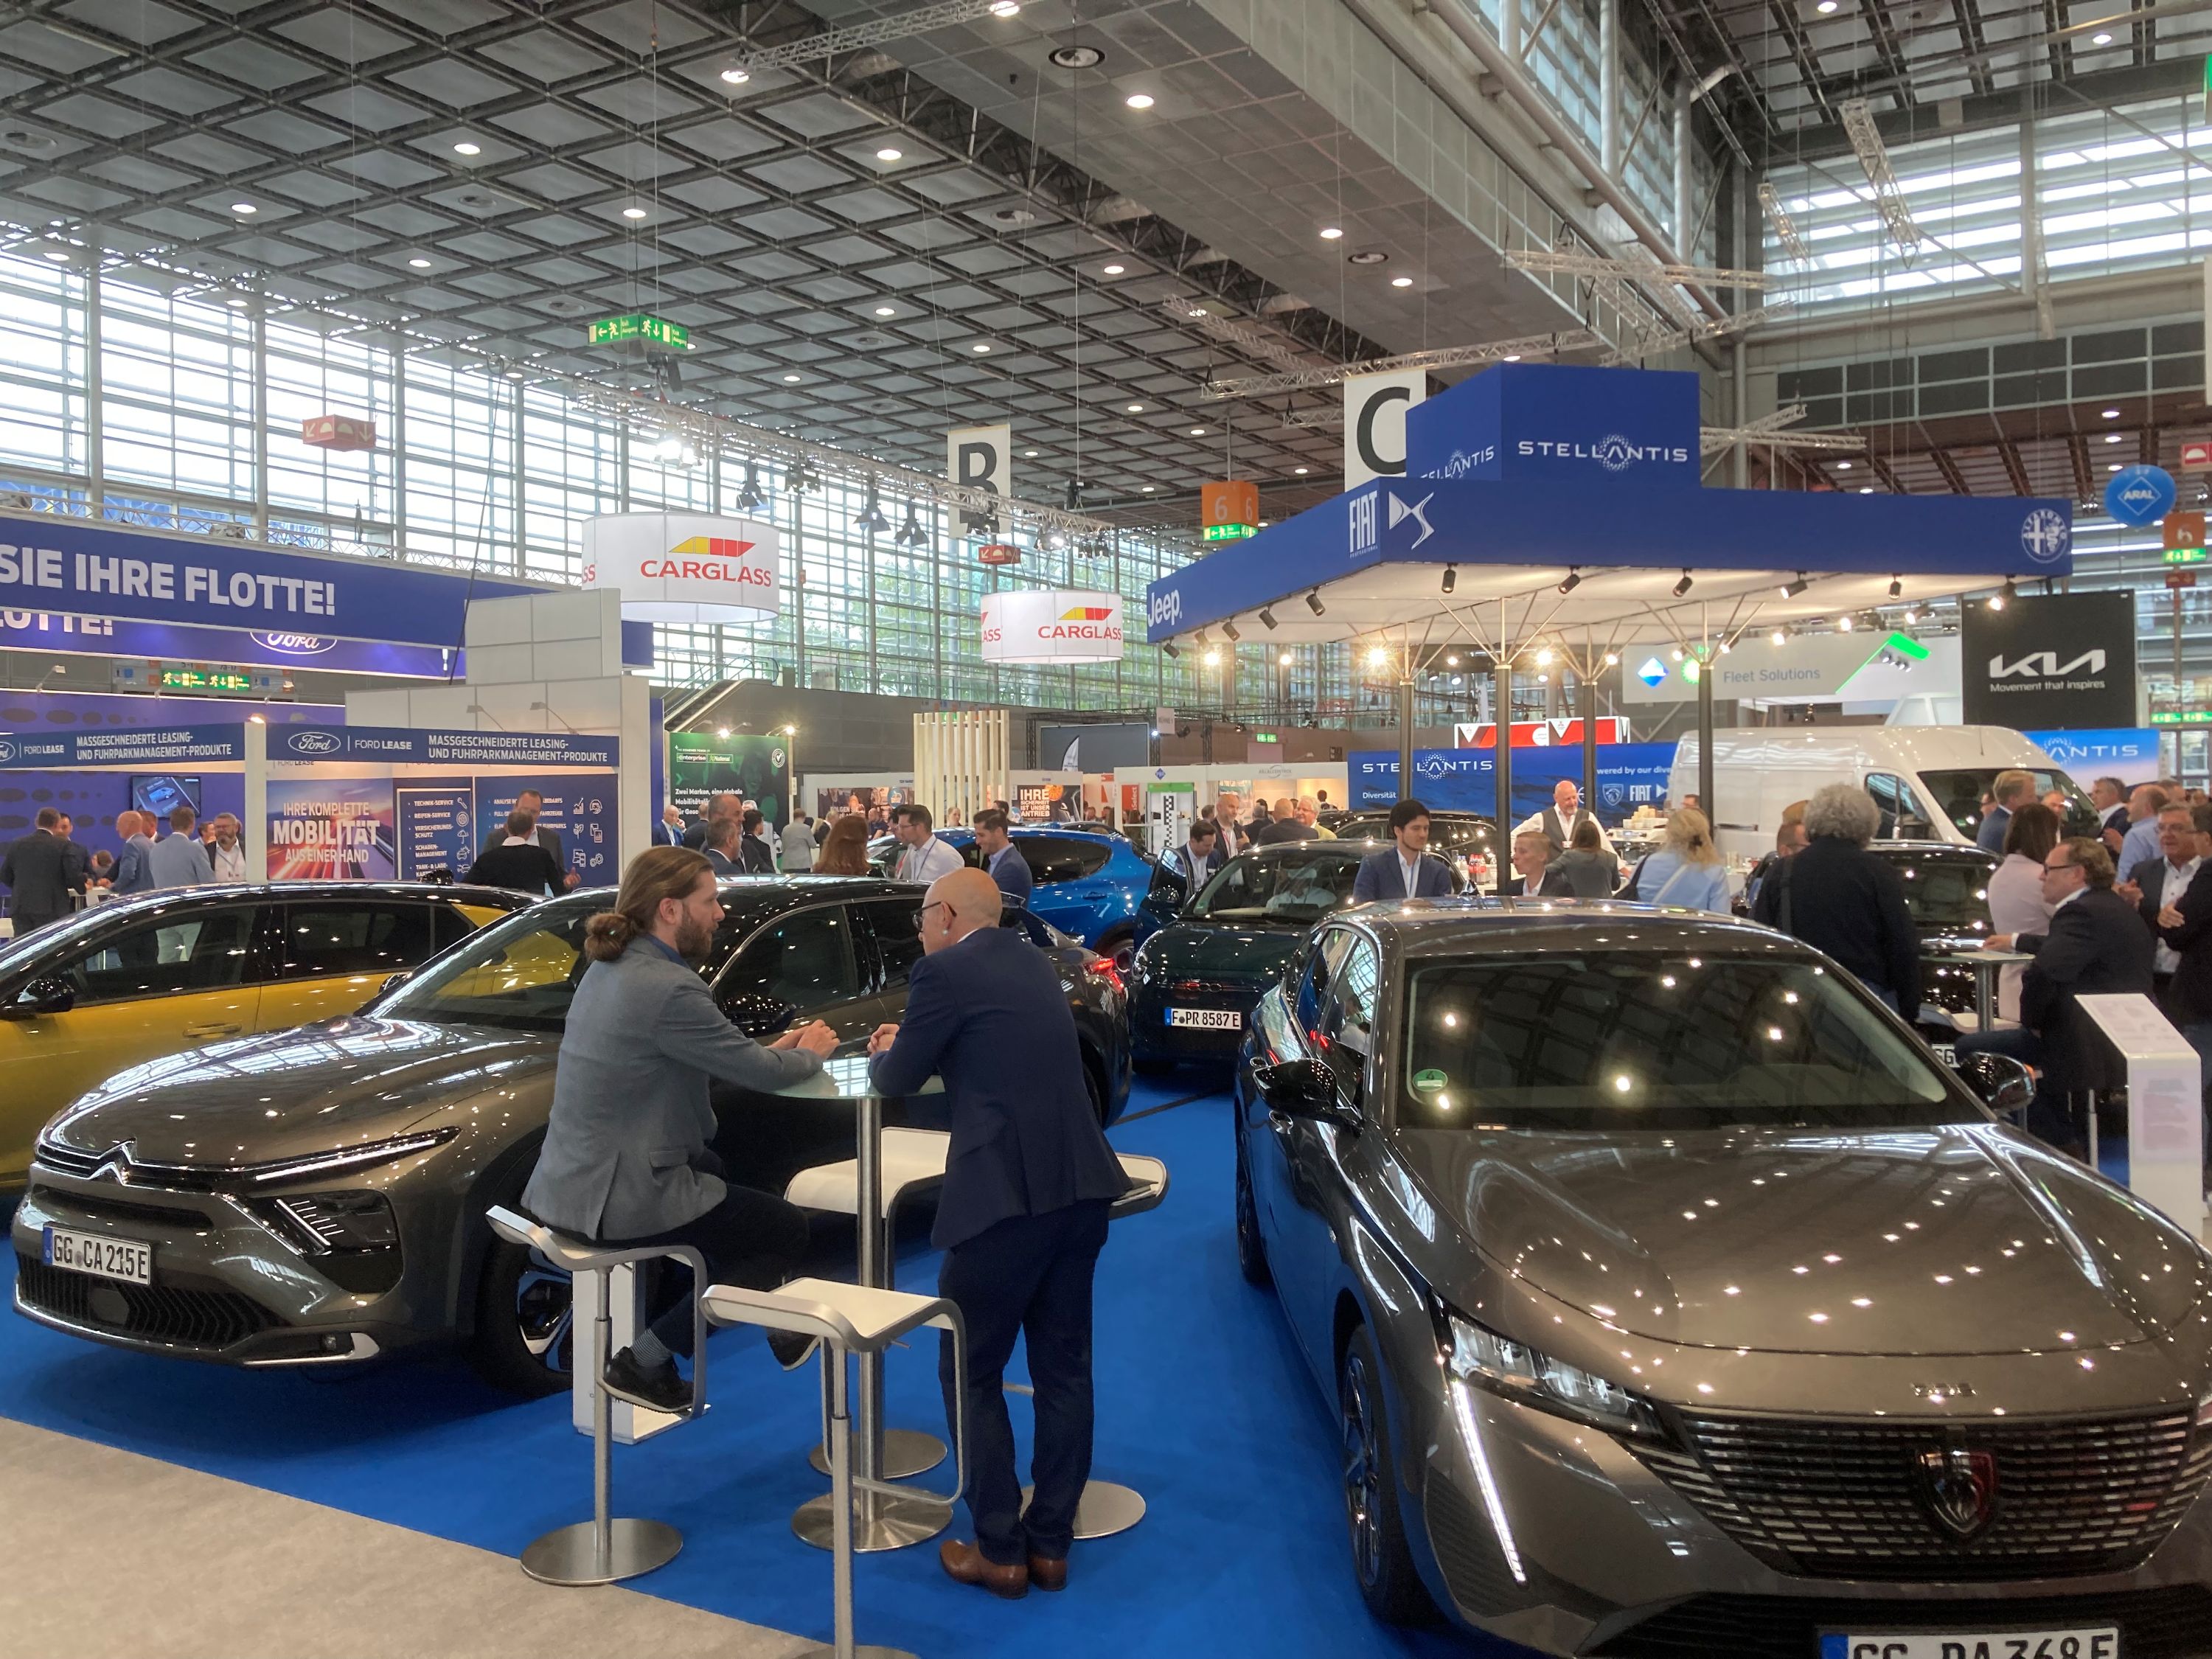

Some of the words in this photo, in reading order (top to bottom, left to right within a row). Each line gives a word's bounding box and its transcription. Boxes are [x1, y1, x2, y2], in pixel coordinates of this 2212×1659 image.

[1357, 386, 1410, 475] C
[1518, 440, 1688, 462] STELLANTIS
[1420, 445, 1495, 479] ELLANTIS
[959, 442, 1000, 525] B
[2123, 489, 2155, 501] ARAL
[1214, 495, 1228, 521] 6
[1245, 497, 1253, 521] 6
[1349, 490, 1378, 553] FIAT
[0, 543, 63, 589] SIE
[75, 553, 175, 599] IHRE
[185, 566, 335, 616] FLOTTE!
[582, 563, 596, 584] SS
[640, 560, 771, 588] CARGLASS
[982, 628, 1001, 643] ASS
[1038, 625, 1121, 641] CARGLASS
[1723, 670, 1755, 683] Fleet
[1759, 668, 1820, 681] Solutions
[1990, 682, 2042, 692] Movement
[2045, 681, 2064, 690] that
[2067, 680, 2105, 691] inspires
[77, 733, 156, 747] MASSGESCHNEIDERTE
[158, 731, 193, 743] LEASING-
[298, 733, 331, 751] Ford
[355, 740, 380, 750] FORD
[381, 740, 412, 751] LEASE
[428, 734, 529, 748] MASSGESCHNEIDERTE
[529, 738, 569, 749] LEASING-
[24, 746, 41, 754] FORD
[42, 745, 64, 754] LEASE
[77, 748, 93, 760] UND
[94, 743, 232, 759] FUHRPARKMANAGEMENT-PRODUKTE
[428, 747, 450, 759] UND
[451, 748, 608, 762] FUHRPARKMANAGEMENT-PRODUKTE
[2049, 745, 2138, 759] ANTIS
[1363, 760, 1492, 773] STELANTIS
[1596, 766, 1623, 774] wered
[1624, 766, 1635, 775] by
[1654, 765, 1672, 773] dive
[1020, 789, 1049, 801] IHRE
[1363, 791, 1397, 799] Diversität
[1630, 785, 1652, 801] FIAT
[283, 802, 307, 816] IHRE
[309, 801, 369, 816] KOMPLETTE
[274, 820, 380, 846] MOBILITÄT
[285, 849, 306, 862] AUS
[307, 849, 338, 863] EINER
[340, 849, 369, 863] HAND
